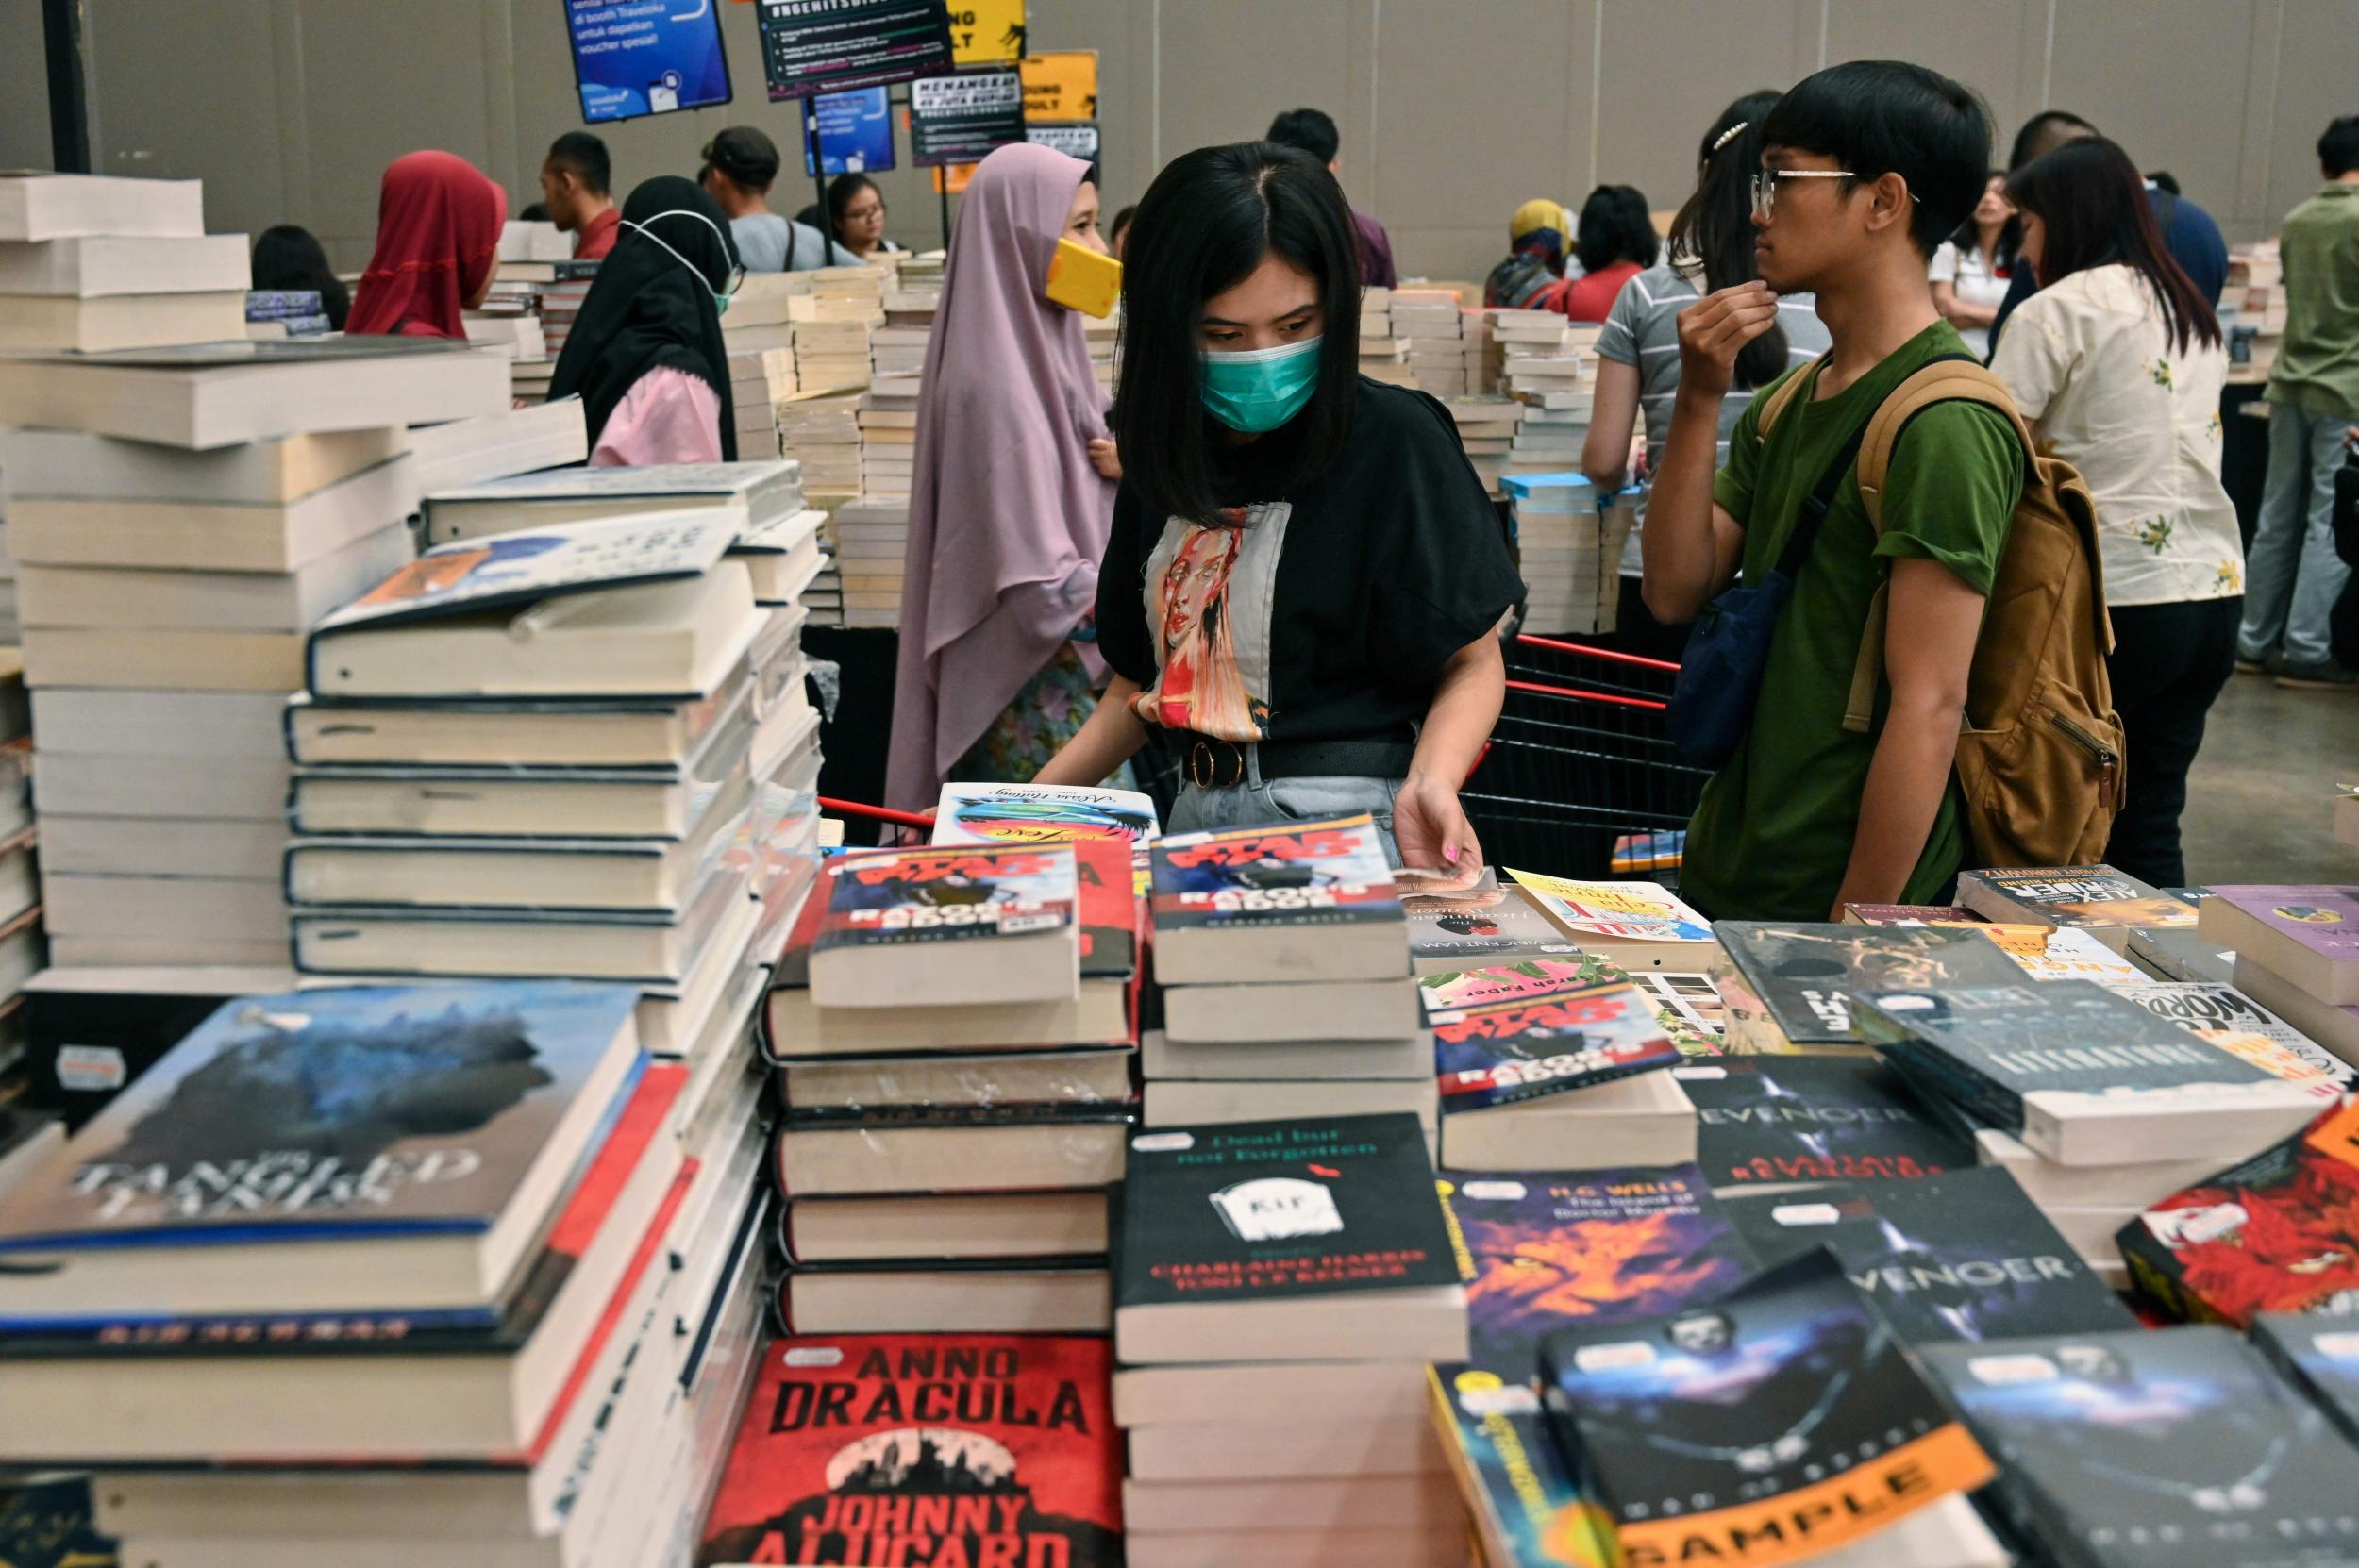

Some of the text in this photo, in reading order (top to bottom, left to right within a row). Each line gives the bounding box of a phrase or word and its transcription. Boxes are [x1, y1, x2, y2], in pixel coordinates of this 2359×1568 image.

[1983, 867, 2115, 876] ANTHONY HOROWITZ
[2002, 881, 2105, 898] RIDER
[2071, 889, 2139, 903] ALEX
[1465, 939, 1546, 948] VINCENT
[1465, 975, 1592, 998] Sarah Faber
[1699, 1106, 1915, 1126] EVENGER
[1604, 1179, 1689, 1197] WELLS
[1848, 1254, 2076, 1293] VENGER
[854, 1345, 1021, 1381] ANNO
[767, 1379, 1092, 1437] DRACULA
[801, 1493, 1031, 1535] JOHNNY
[1621, 1460, 1934, 1567] SAMPLE
